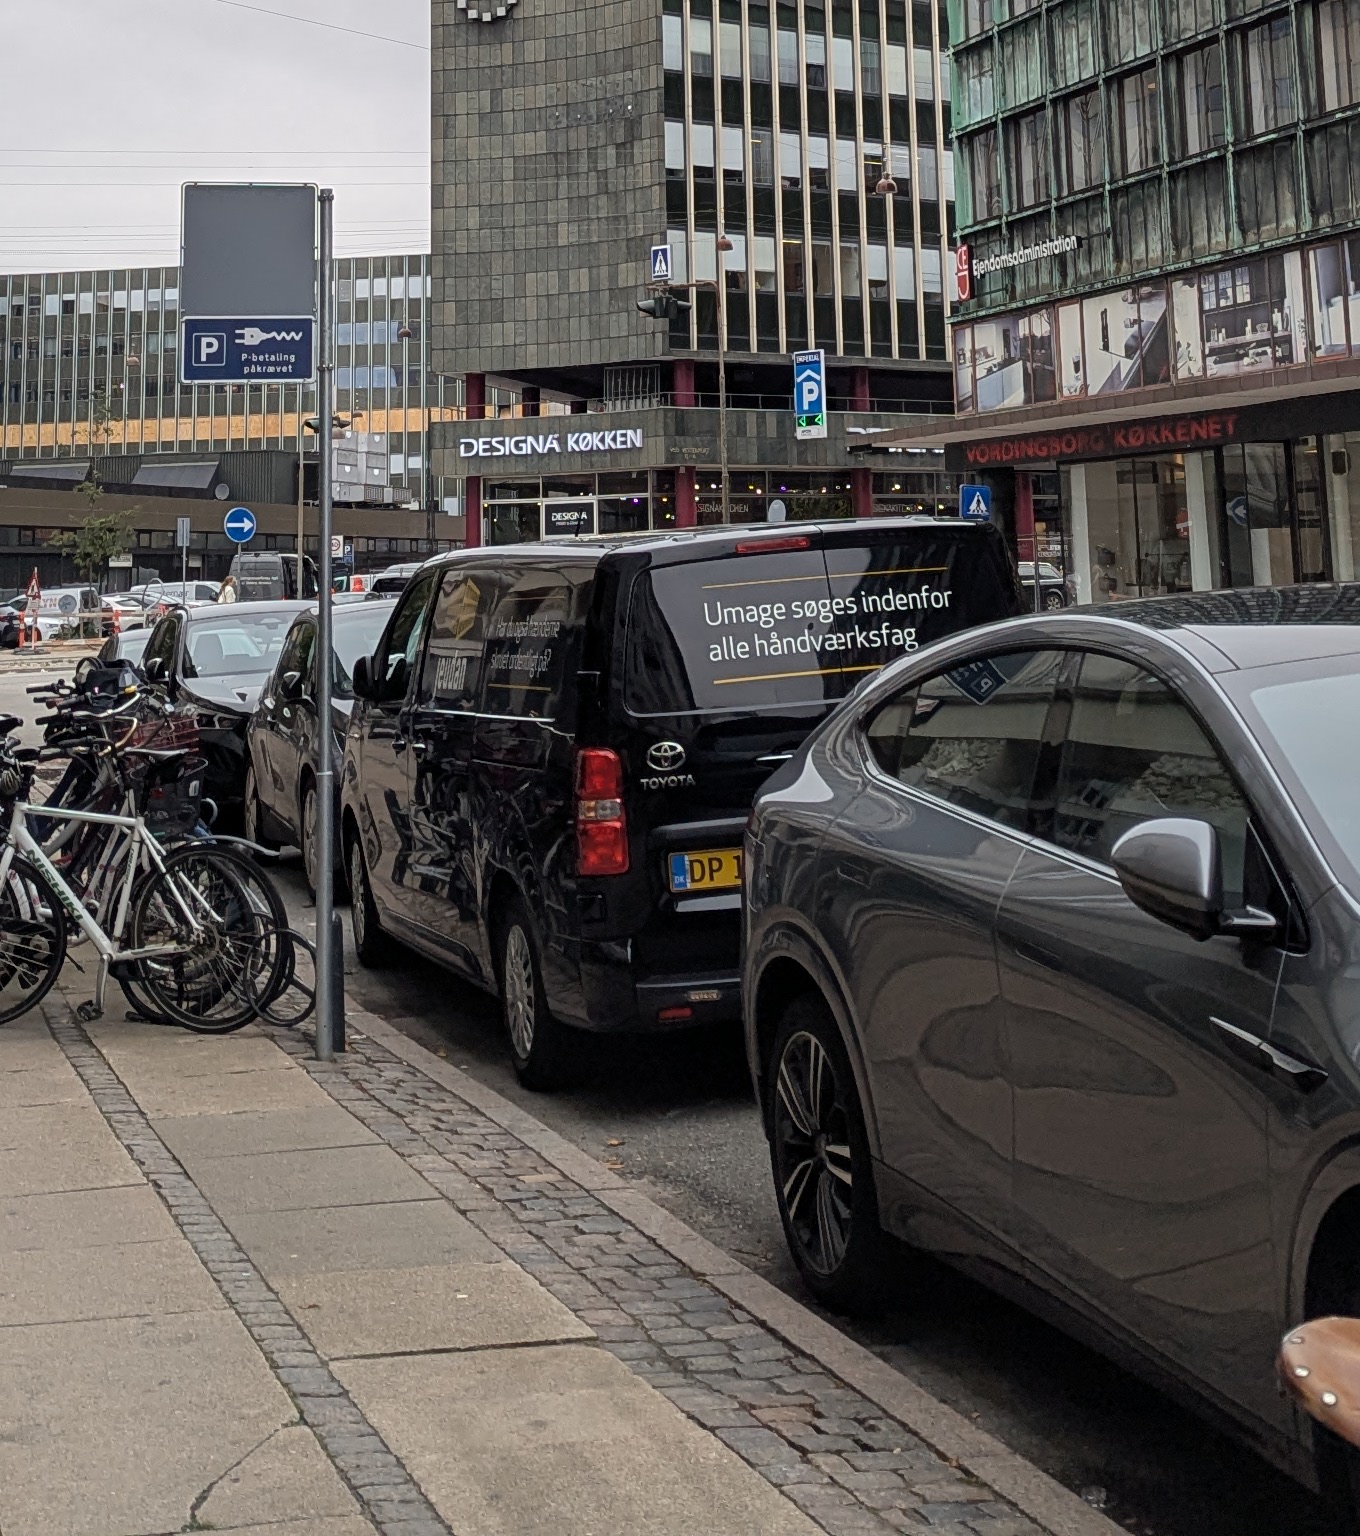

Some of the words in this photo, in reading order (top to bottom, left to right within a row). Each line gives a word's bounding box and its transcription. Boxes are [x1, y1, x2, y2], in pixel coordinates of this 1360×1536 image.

[972, 235, 1078, 279] Ejendomsadministration
[201, 337, 219, 361] P
[241, 352, 296, 365] P-betaling
[243, 363, 293, 375] påkrævet
[803, 381, 819, 410] P
[459, 433, 562, 457] DESIGNA
[567, 428, 643, 452] KØKKEN
[966, 431, 1105, 464] VORDINGBORG
[1113, 415, 1238, 448] KØKKENET
[703, 600, 787, 629] Umage
[790, 596, 858, 624] søges
[861, 585, 953, 613] indenfor
[708, 637, 750, 662] alle
[755, 623, 919, 657] håndværksfag
[640, 774, 696, 792] TOYOTA
[27, 849, 83, 921] NISHIKI
[674, 875, 685, 884] DK
[690, 857, 723, 883] DP
